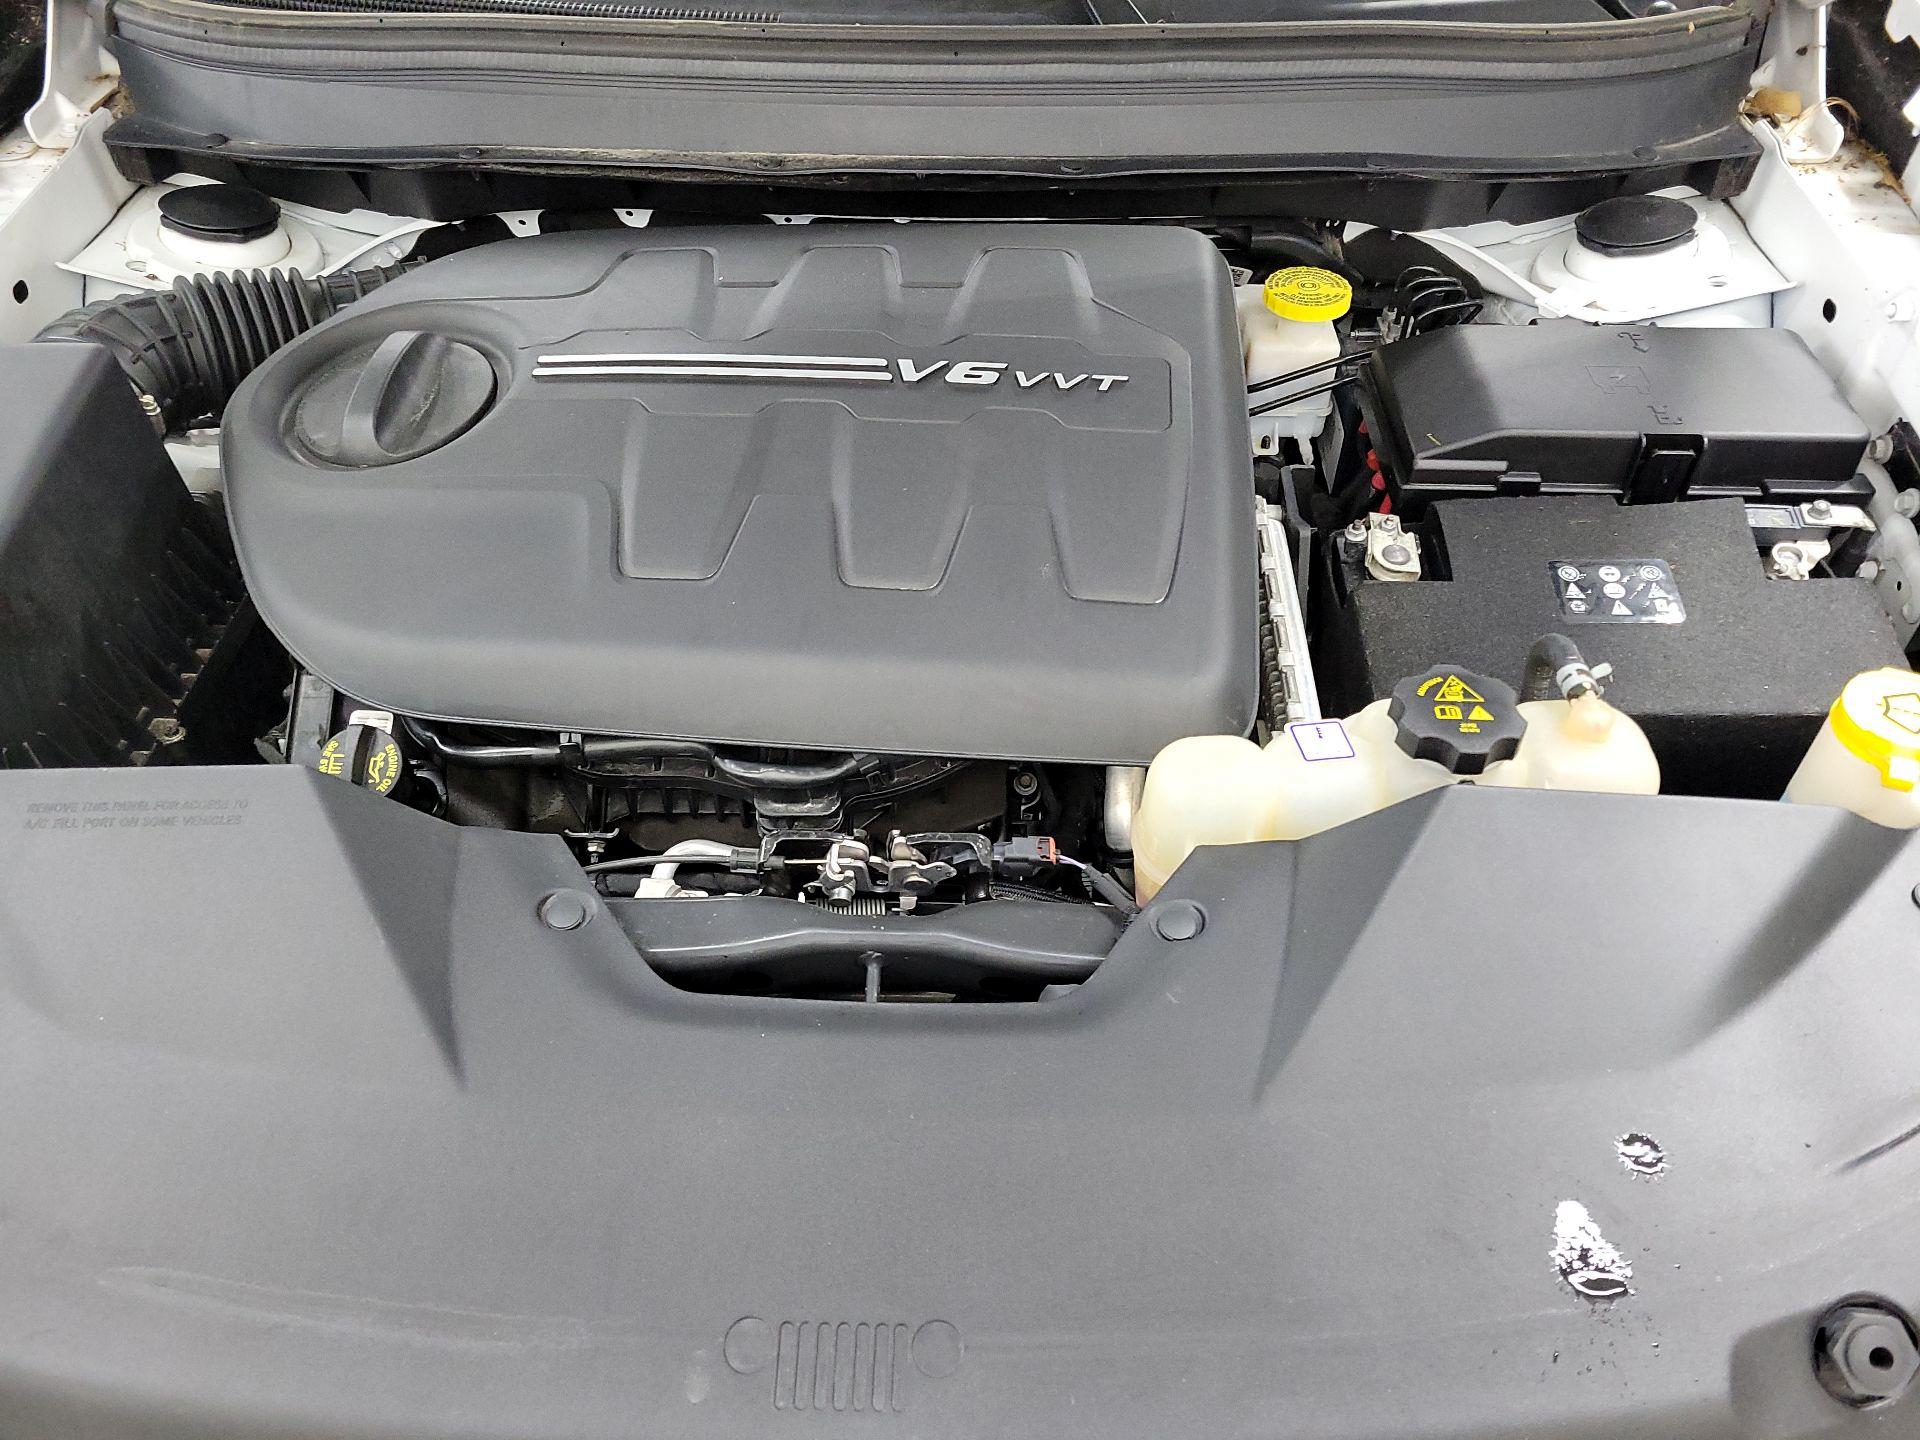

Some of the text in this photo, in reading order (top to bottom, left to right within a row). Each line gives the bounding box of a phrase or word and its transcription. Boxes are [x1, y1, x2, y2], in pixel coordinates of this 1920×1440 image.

[897, 358, 1129, 391] V6 VVT
[375, 743, 398, 793] ENGINE OIL
[27, 802, 79, 813] REMOVE
[81, 802, 109, 812] THIS
[153, 801, 180, 811] FOR
[82, 816, 116, 828] PORT
[119, 816, 140, 828] ON
[182, 815, 242, 826] VEHICLES
